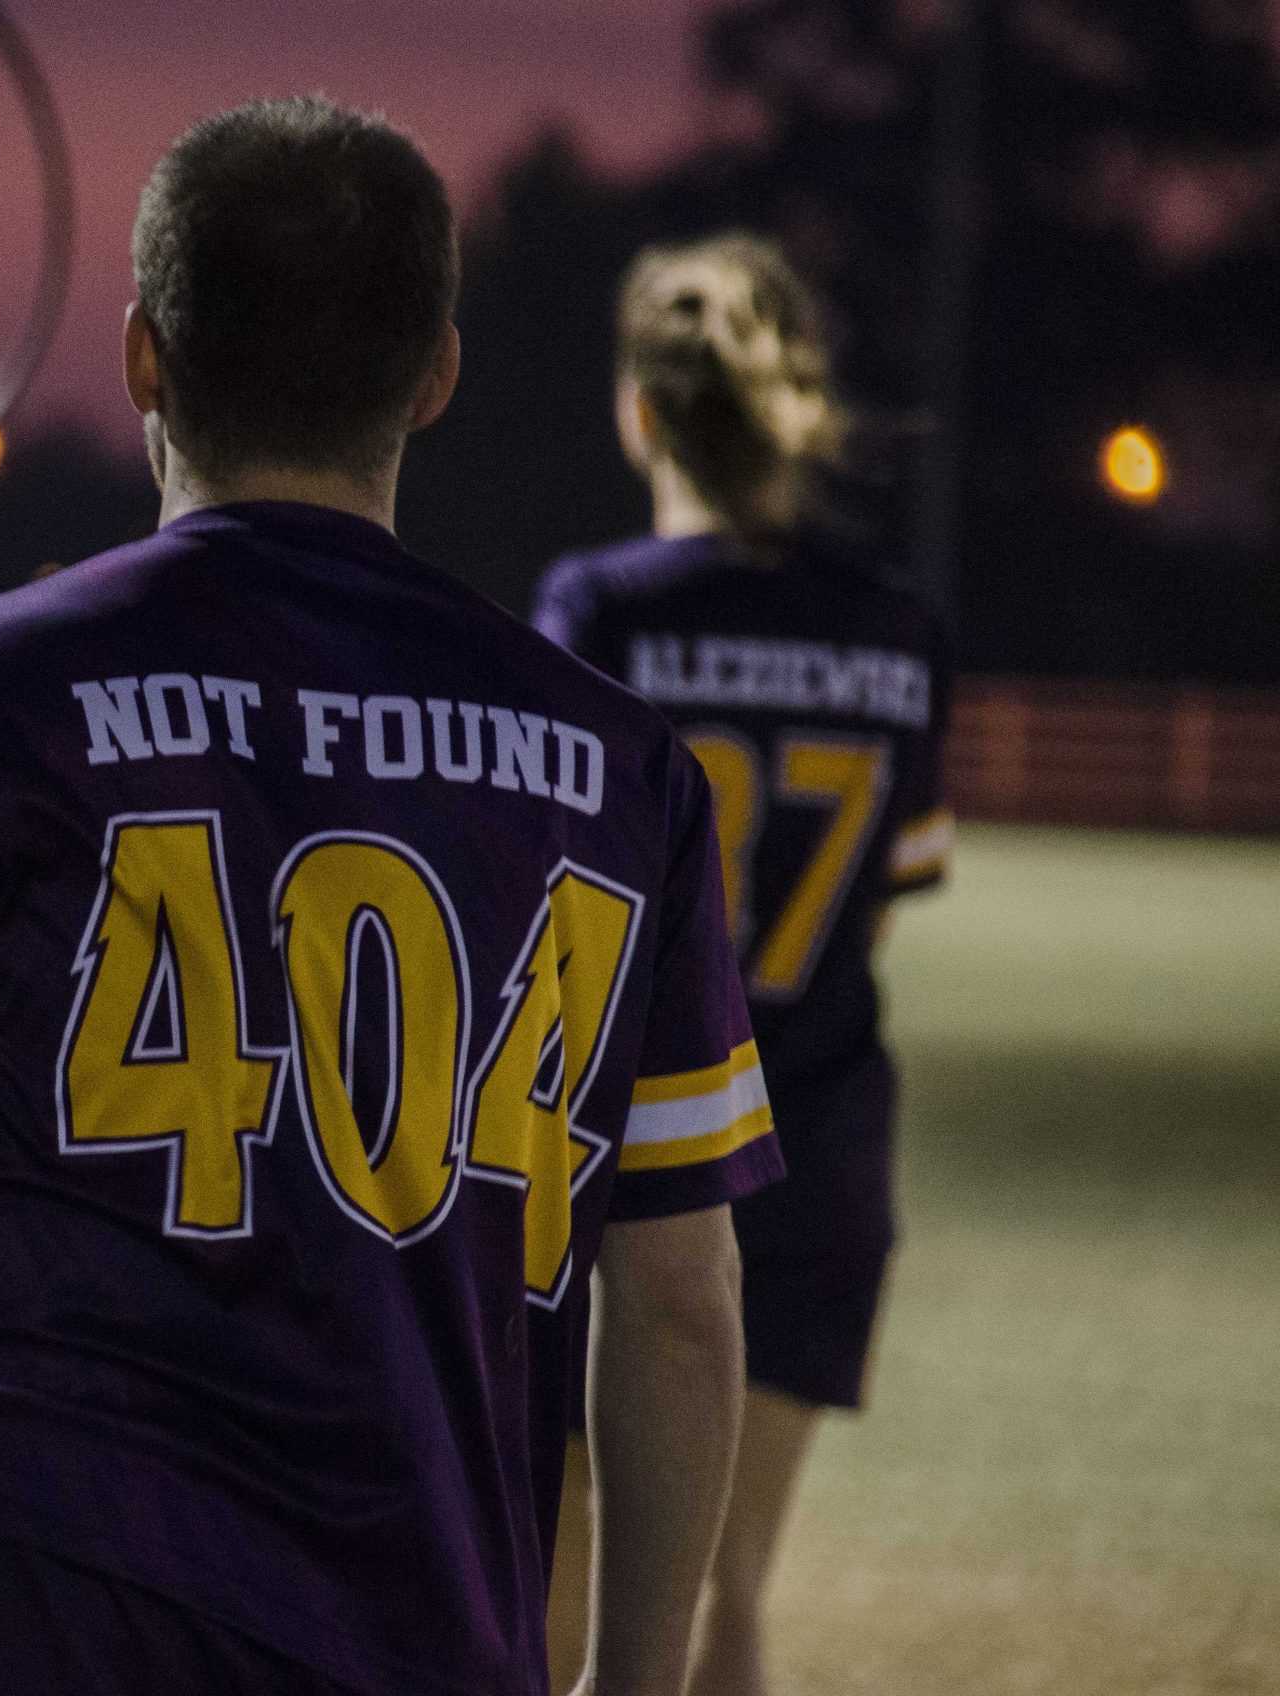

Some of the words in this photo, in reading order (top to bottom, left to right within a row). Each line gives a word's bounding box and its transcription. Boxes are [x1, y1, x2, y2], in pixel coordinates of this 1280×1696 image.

[72, 672, 261, 766] NOT
[297, 688, 605, 816] FOUND
[56, 809, 645, 1312] 404
